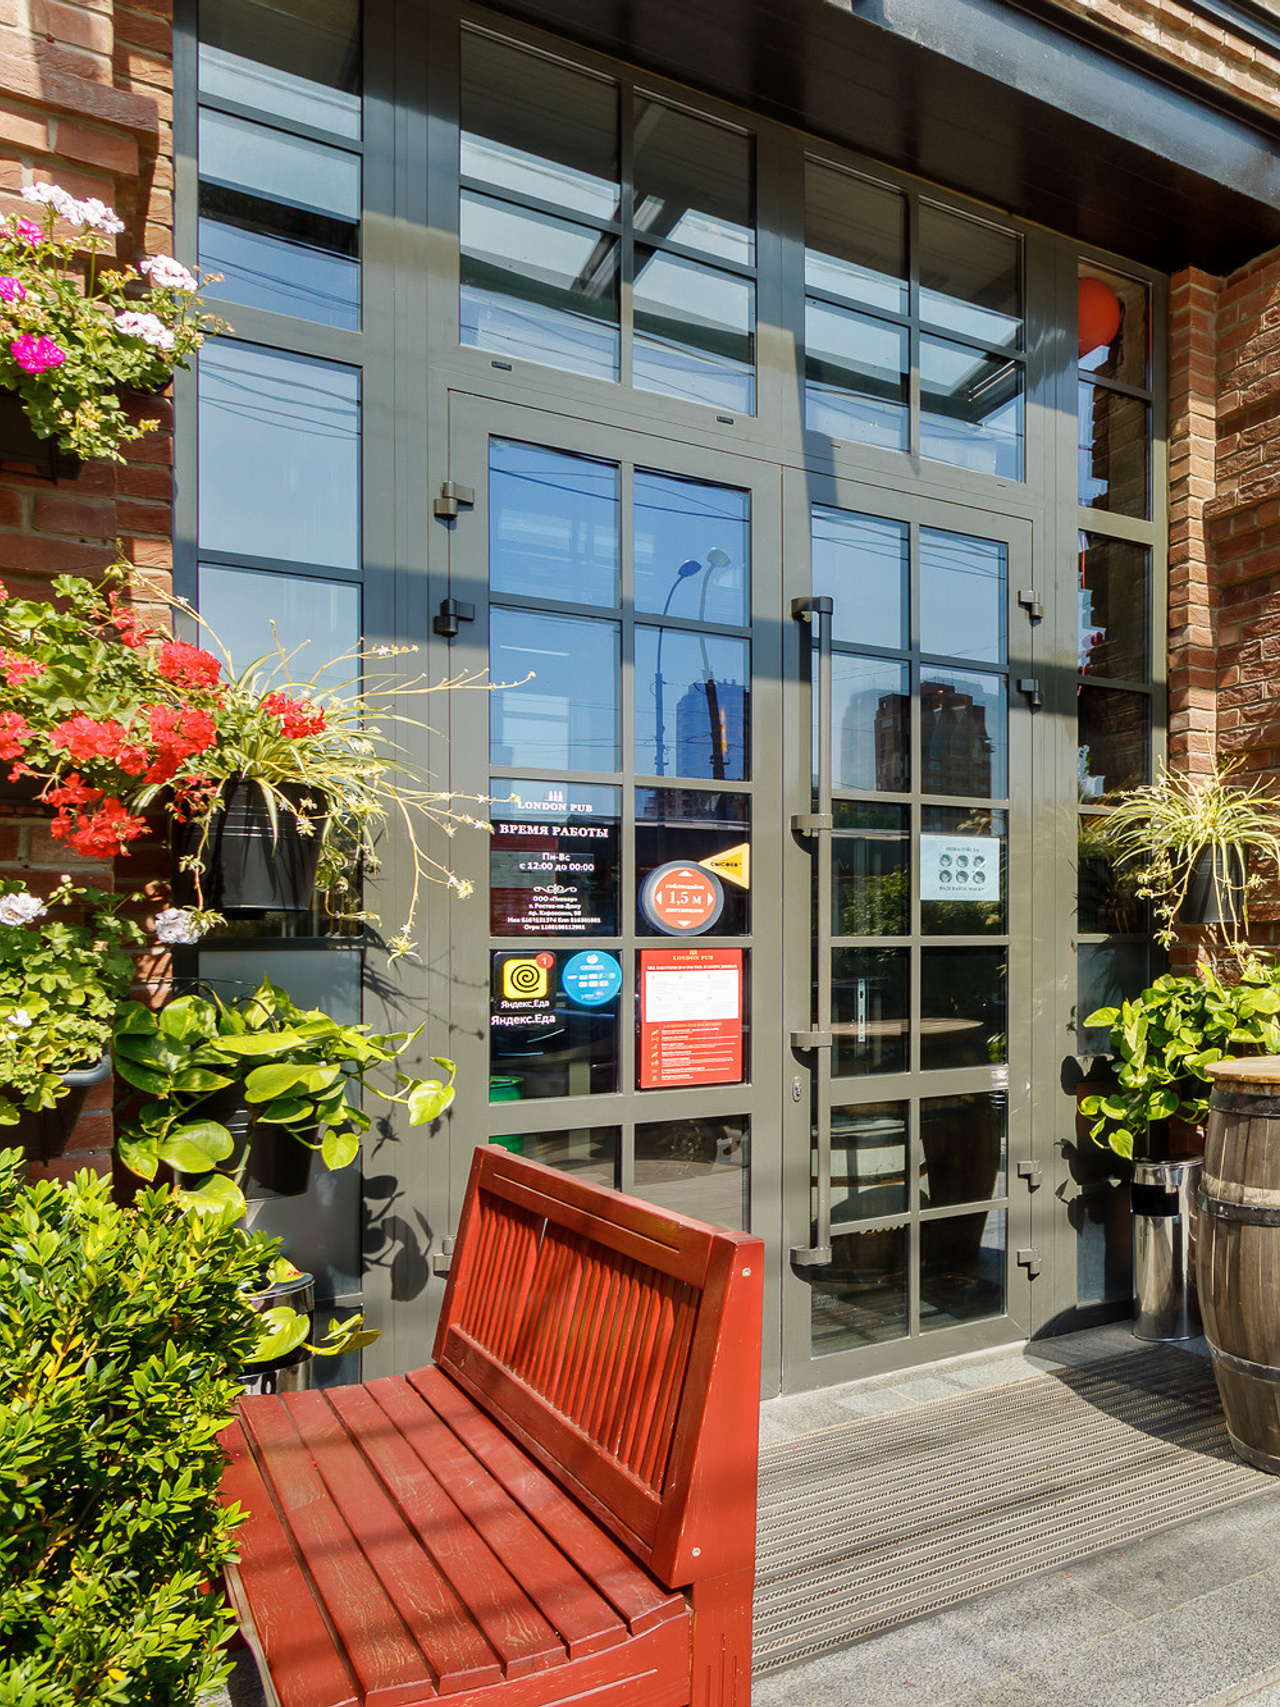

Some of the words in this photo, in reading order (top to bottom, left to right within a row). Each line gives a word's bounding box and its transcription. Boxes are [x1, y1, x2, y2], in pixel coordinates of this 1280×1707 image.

[517, 801, 567, 811] LONDON
[570, 803, 593, 812] PUB
[499, 824, 549, 835] ВРЕМЯ
[552, 826, 608, 838] РАБОТЫ
[542, 852, 571, 862] Пн-Вс
[527, 862, 554, 871] 12:00
[554, 863, 567, 872] до
[568, 863, 595, 872] 00:00
[670, 891, 690, 906] 1,5
[535, 903, 582, 911] Ростов-на-Дону
[540, 957, 547, 965] 1
[500, 1000, 550, 1009] Яндекс.Еда
[490, 1014, 557, 1026] Яндекс.Еда
